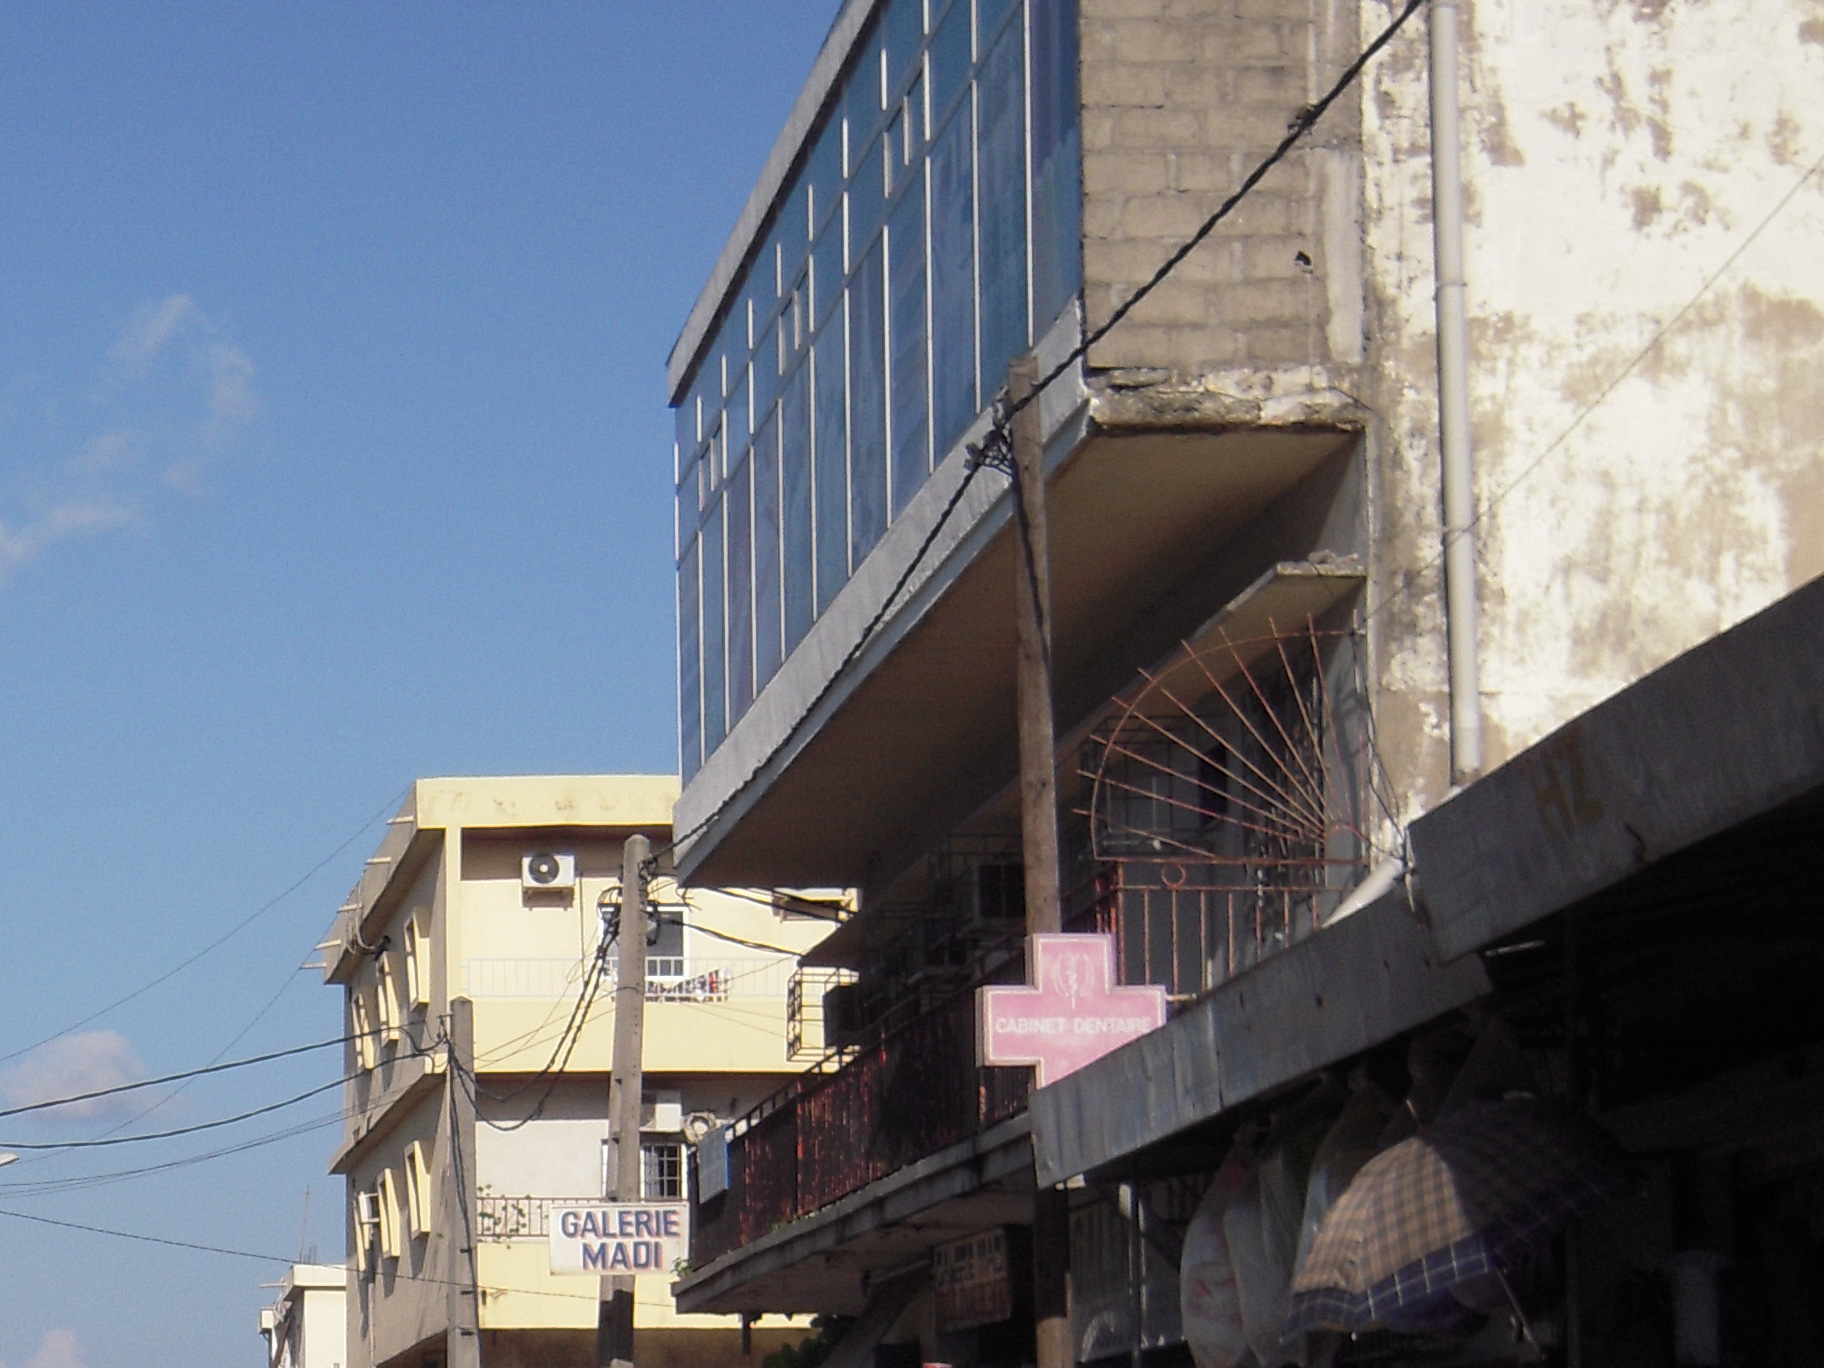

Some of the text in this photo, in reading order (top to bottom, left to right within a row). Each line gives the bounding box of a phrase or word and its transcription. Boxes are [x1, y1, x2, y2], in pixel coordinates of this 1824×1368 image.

[995, 1017, 1152, 1034] CABINET DENTAIRE
[560, 1209, 681, 1239] GALERIE
[581, 1241, 664, 1271] MADI
